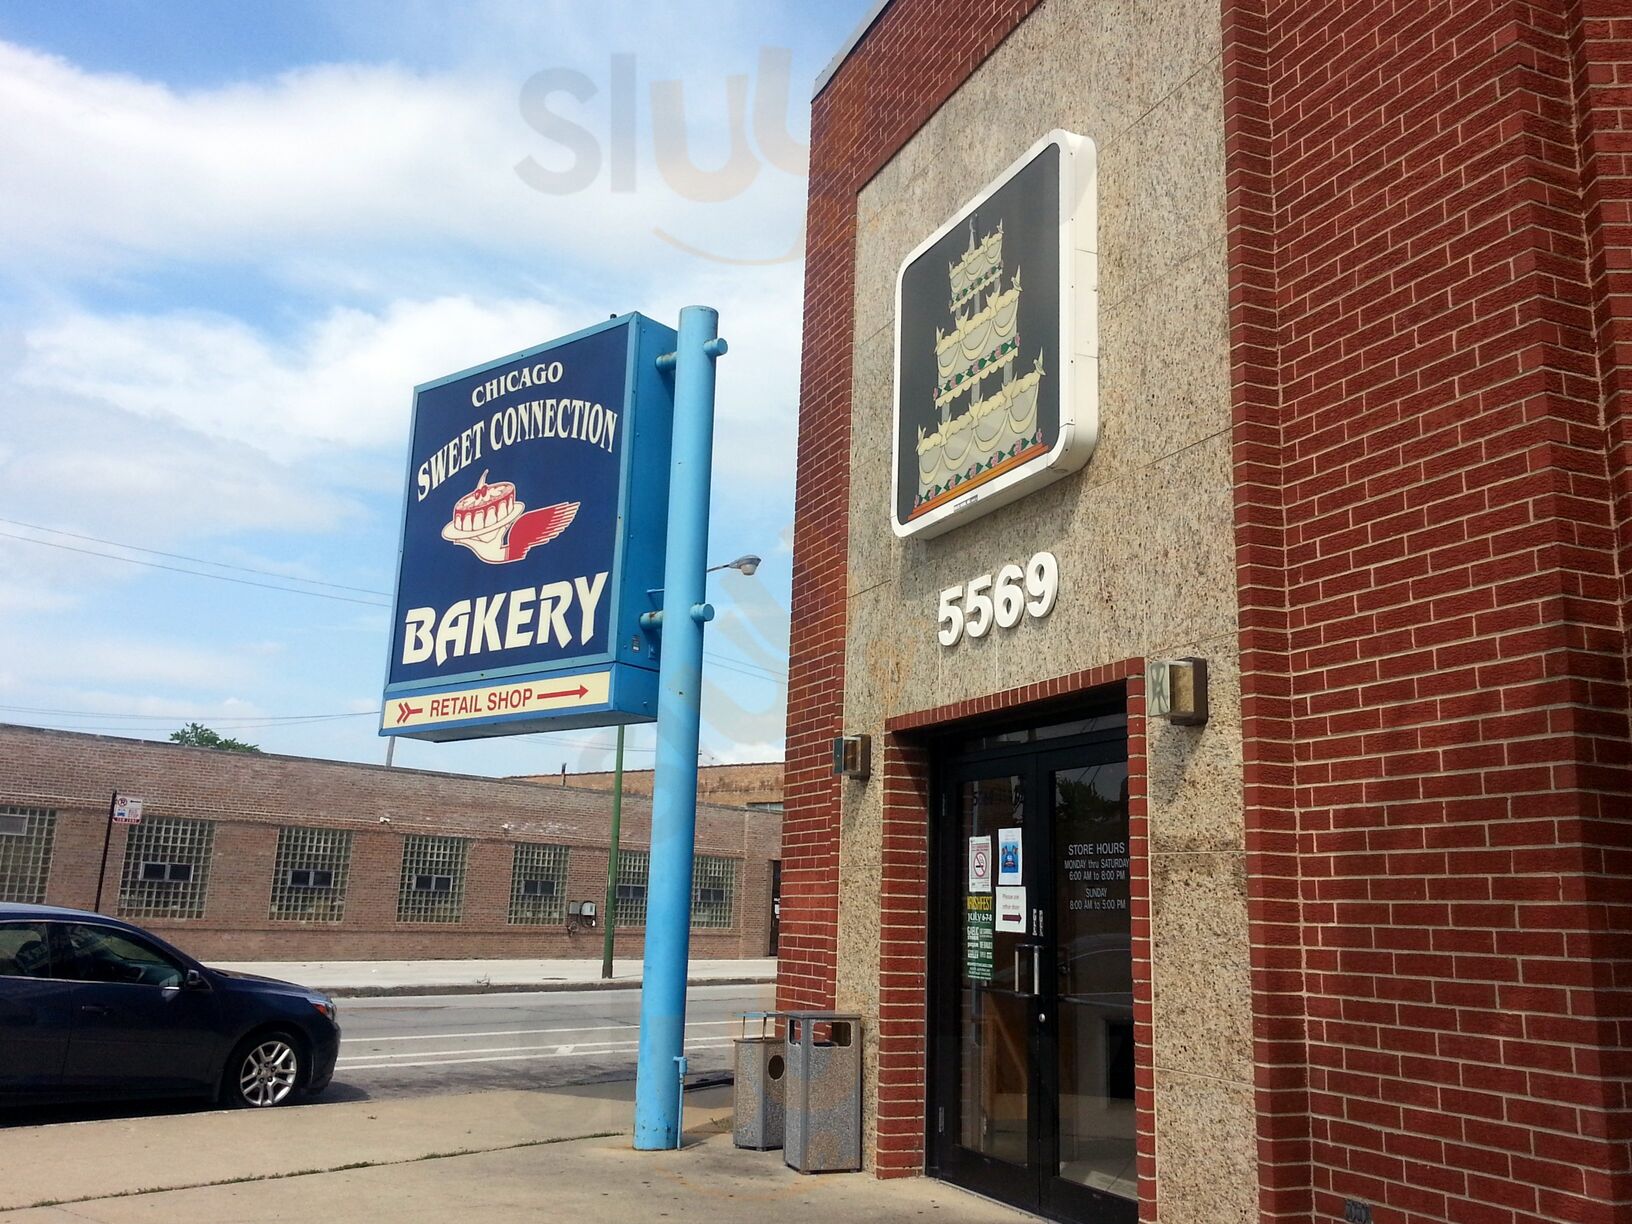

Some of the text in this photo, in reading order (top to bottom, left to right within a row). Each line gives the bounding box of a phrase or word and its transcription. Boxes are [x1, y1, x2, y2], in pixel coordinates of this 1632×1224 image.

[471, 361, 564, 408] CHICAGO
[417, 398, 618, 502] SWEET CONNECTION
[938, 551, 1059, 647] 5569
[402, 571, 609, 667] BAKERY
[429, 687, 533, 718] RETAIL SHOP
[1068, 842, 1125, 856] STORE HOURS
[1064, 859, 1087, 869] MONDAY
[1101, 858, 1129, 869] SATURDAY
[1083, 871, 1092, 880] AM
[1093, 871, 1100, 880] to
[1116, 870, 1125, 880] PM
[1086, 887, 1108, 898] SUNDAY
[1084, 900, 1093, 909] AM
[1117, 899, 1126, 909] PM
